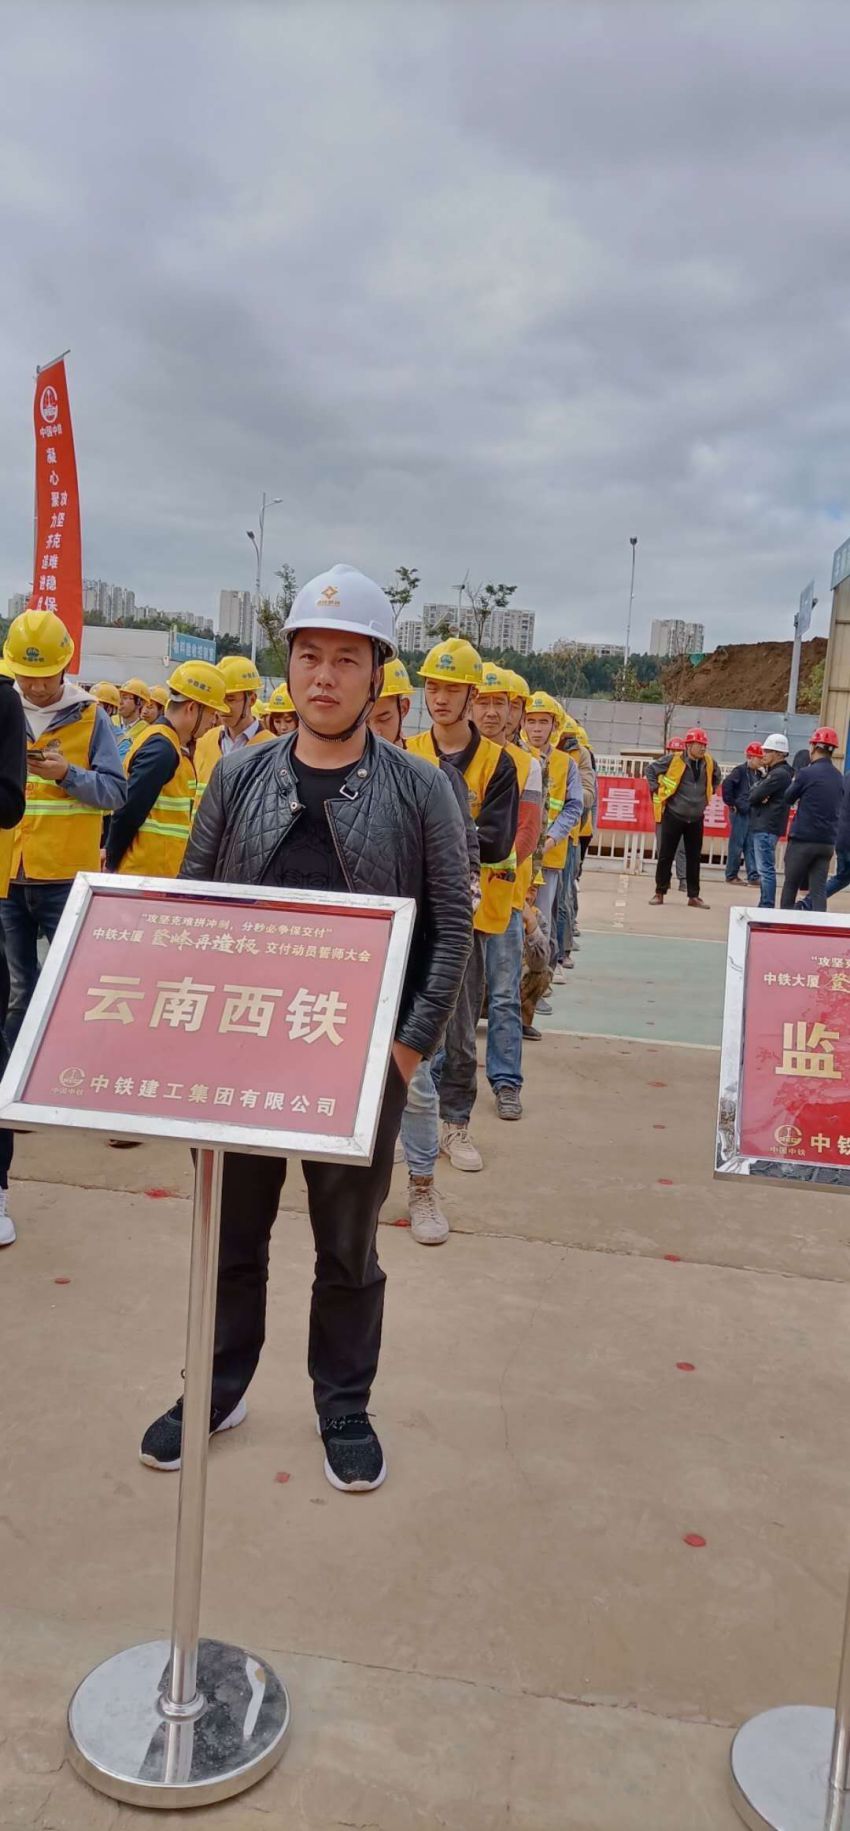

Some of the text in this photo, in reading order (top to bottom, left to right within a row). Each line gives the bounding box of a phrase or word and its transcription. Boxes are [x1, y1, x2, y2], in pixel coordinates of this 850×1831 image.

[602, 787, 640, 821] 量
[93, 927, 144, 943] 中铁大厦
[265, 942, 371, 962] 交付动员誓师大会
[763, 971, 820, 988] 中铁大厦
[84, 975, 349, 1047] 云南西铁
[775, 1021, 842, 1079] 监
[89, 1074, 337, 1117] 中铁建工集团有限公司
